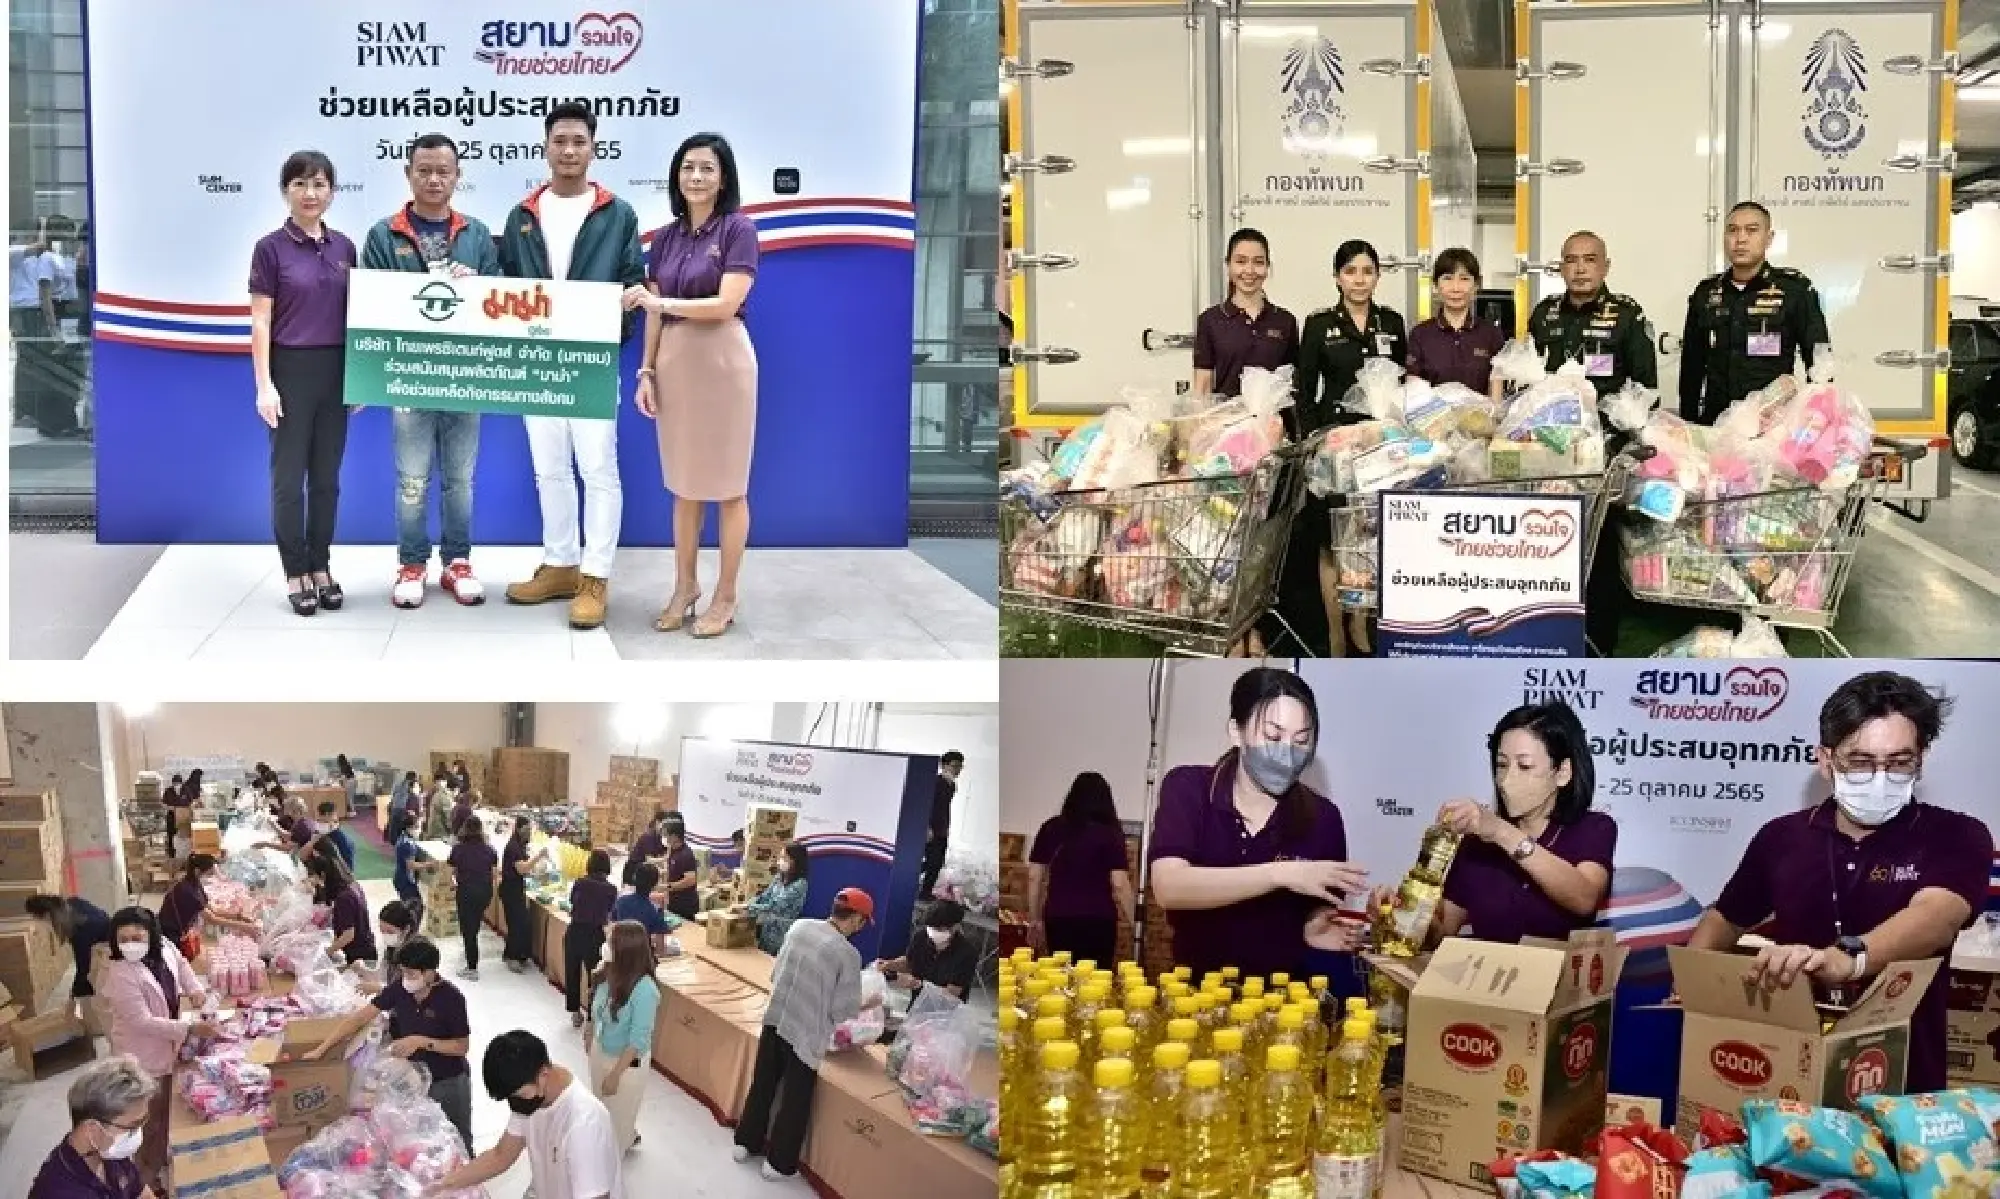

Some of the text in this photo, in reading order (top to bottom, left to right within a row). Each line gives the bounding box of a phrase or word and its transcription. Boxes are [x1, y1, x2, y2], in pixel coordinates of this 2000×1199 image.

[358, 21, 427, 43] SIAM
[481, 20, 571, 48] สยาม
[358, 46, 445, 67] PIWAT
[494, 51, 611, 75] ไทยช่วยไทย
[489, 140, 546, 166] ตุลาค
[1265, 166, 1364, 192] กองทัพบก
[1784, 166, 1883, 192] กองทัพบก
[1443, 512, 1517, 535] สยาม
[1523, 668, 1587, 688] SIAM
[1636, 669, 1782, 698] สยาม รวมใจ
[1648, 698, 1758, 722] ไทยช่วยไทย
[1609, 777, 1633, 796] 25
[1639, 781, 1707, 803] ตุลาคม
[1712, 782, 1764, 803] 2565
[1443, 1033, 1496, 1059] COOK
[1715, 1050, 1766, 1078] COOK
